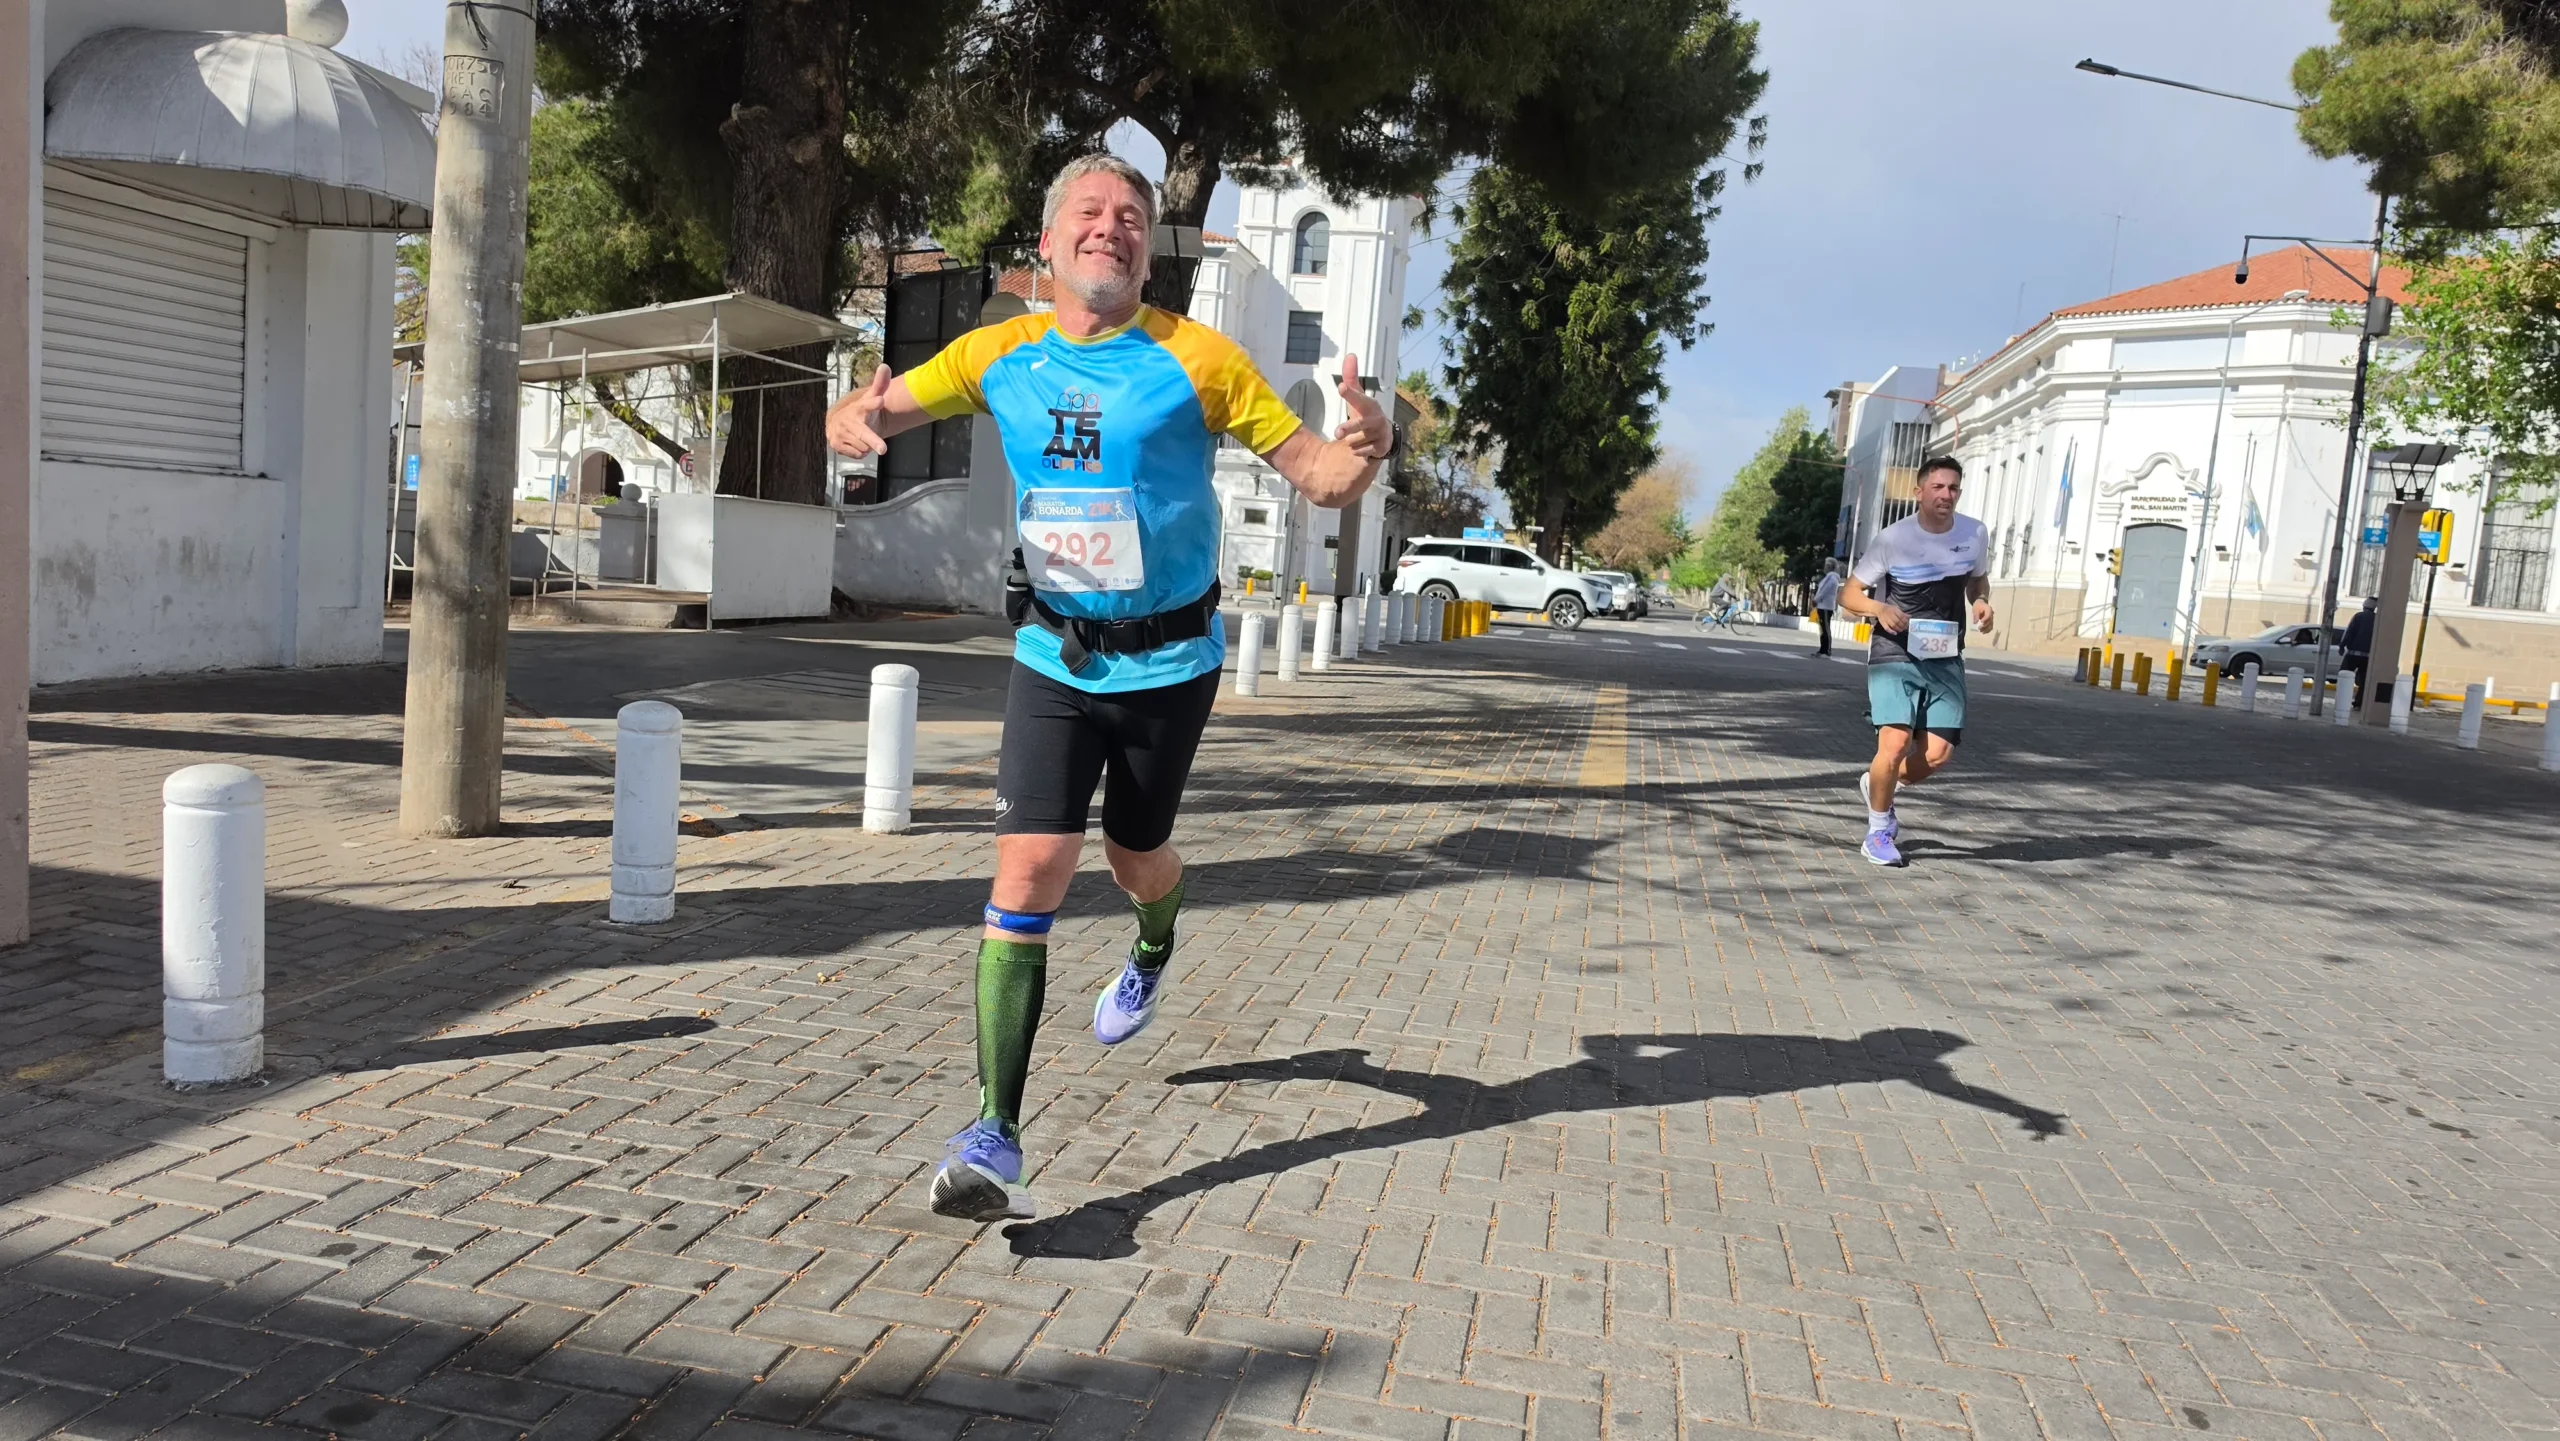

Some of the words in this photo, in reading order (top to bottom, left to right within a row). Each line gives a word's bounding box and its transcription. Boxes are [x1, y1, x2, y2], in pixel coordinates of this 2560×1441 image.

[1041, 457, 1104, 474] OLIMPICO
[1038, 506, 1084, 516] BONARDA
[1043, 531, 1115, 567] 292
